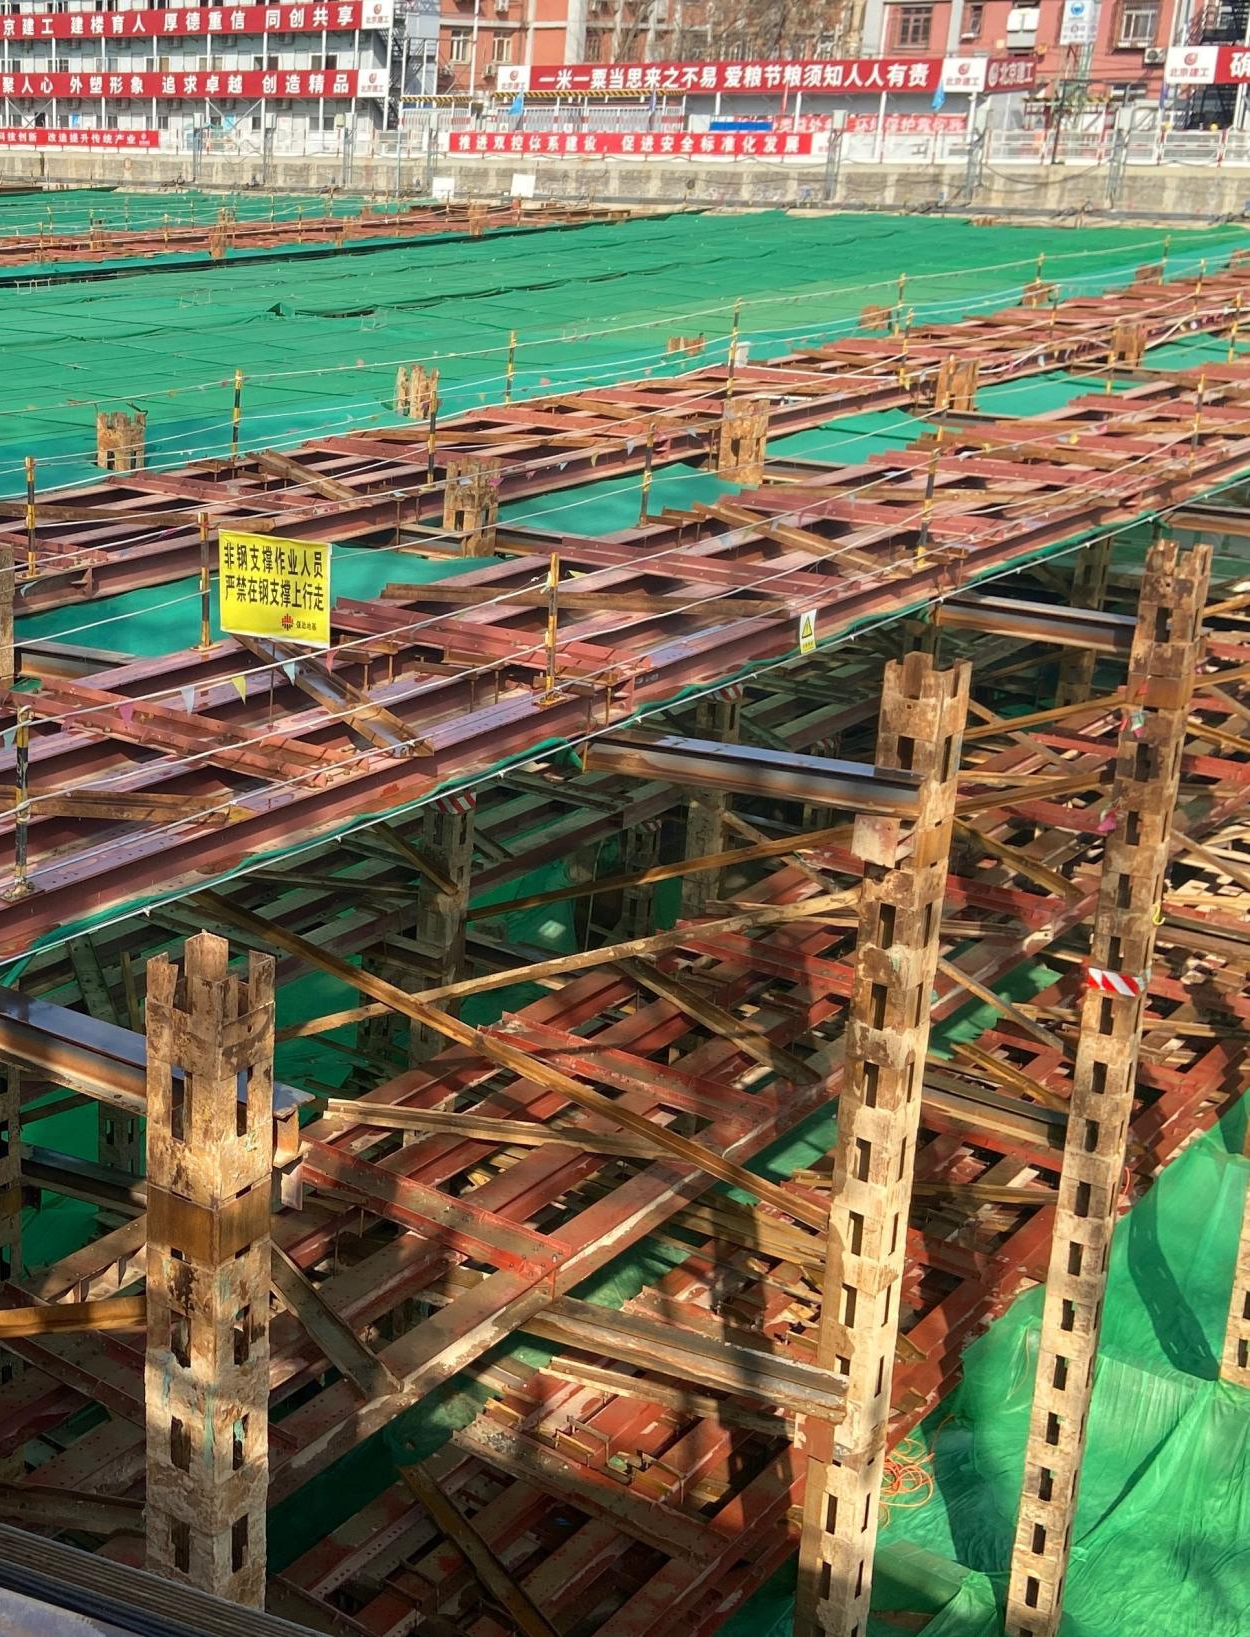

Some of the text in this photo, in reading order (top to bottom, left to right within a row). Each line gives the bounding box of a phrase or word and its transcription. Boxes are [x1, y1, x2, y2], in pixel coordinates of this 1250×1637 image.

[70, 15, 146, 35] 建楼育人
[163, 10, 245, 32] 厚德重信
[265, 6, 353, 29] 同创共享
[538, 63, 930, 89] 一米一粟当思来之不易 爱粮节粮须知人人有责
[946, 77, 980, 86] 北京建工
[999, 61, 1034, 83] 北京建工
[1170, 67, 1210, 77] 北京建工
[70, 76, 144, 95] 外塑形象
[162, 75, 243, 94] 追求卓越
[262, 74, 349, 94] 创造精品
[47, 132, 136, 145] 改造提升传统产业
[224, 541, 323, 579] 非钢支撑作业人员
[225, 574, 324, 611] 严禁在钢支撑上行走
